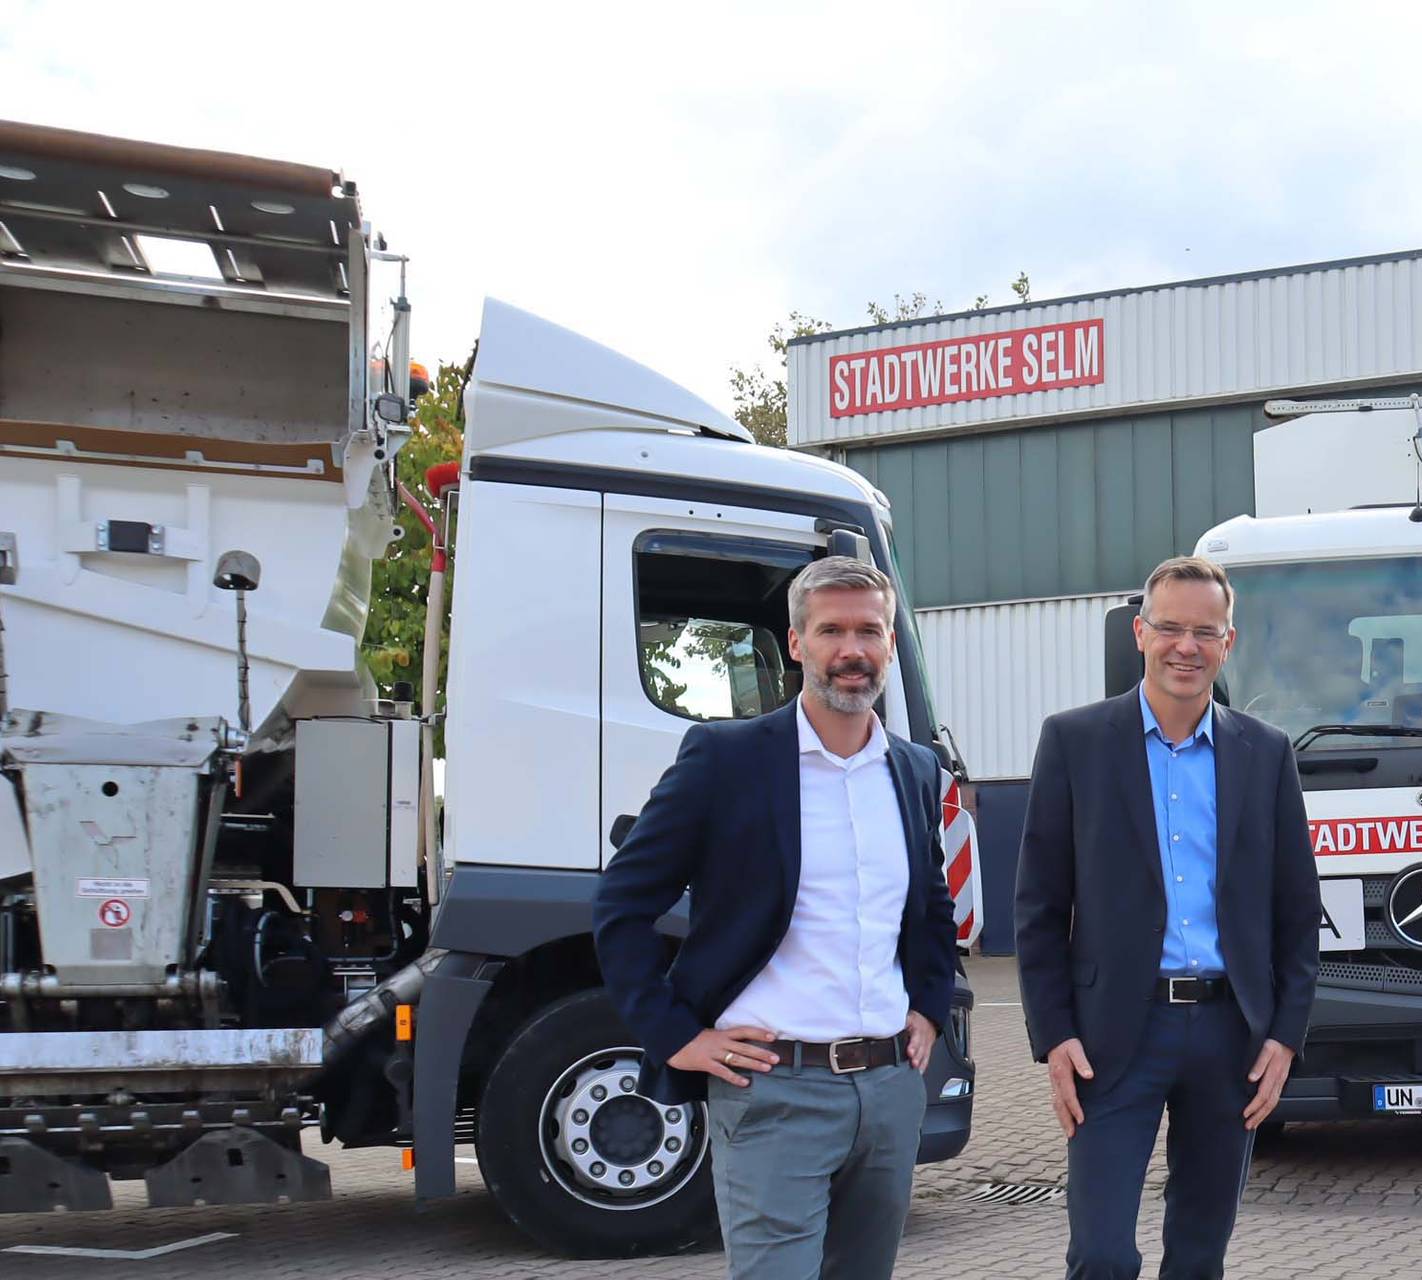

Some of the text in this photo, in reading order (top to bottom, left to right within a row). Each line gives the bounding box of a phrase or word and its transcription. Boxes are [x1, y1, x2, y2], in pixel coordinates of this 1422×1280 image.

[834, 326, 1099, 410] STADTWERKE SELM
[1387, 1088, 1413, 1106] UN
